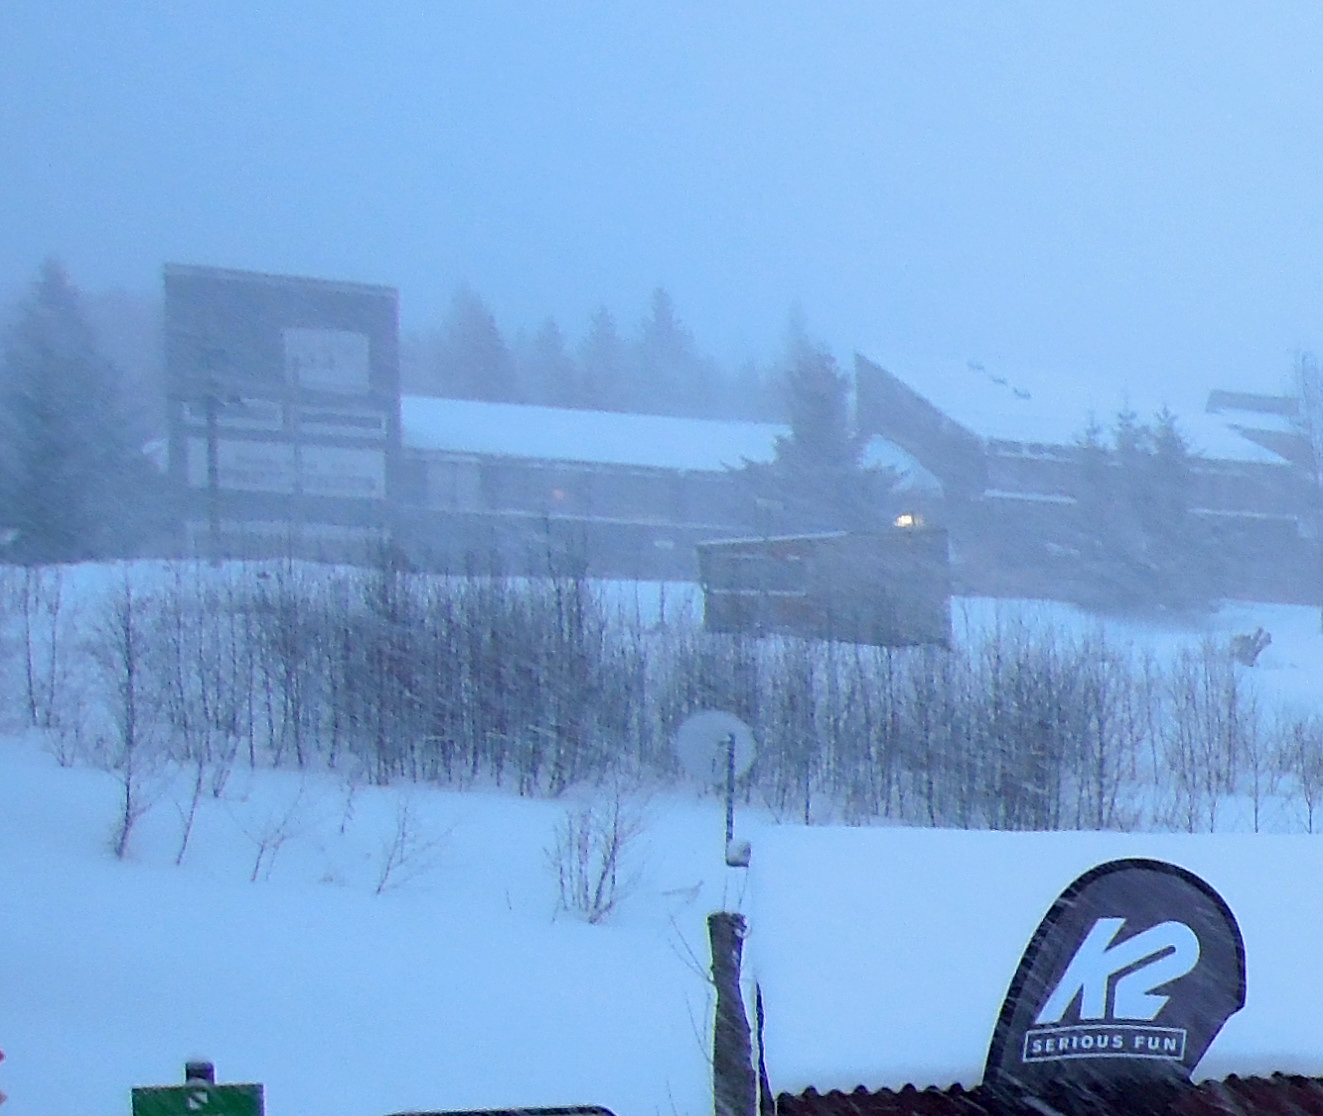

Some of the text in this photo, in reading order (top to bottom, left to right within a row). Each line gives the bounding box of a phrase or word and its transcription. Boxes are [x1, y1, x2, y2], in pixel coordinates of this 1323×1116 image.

[1035, 918, 1200, 1024] K2
[1031, 1035, 1177, 1053] SERIOUS FUN
